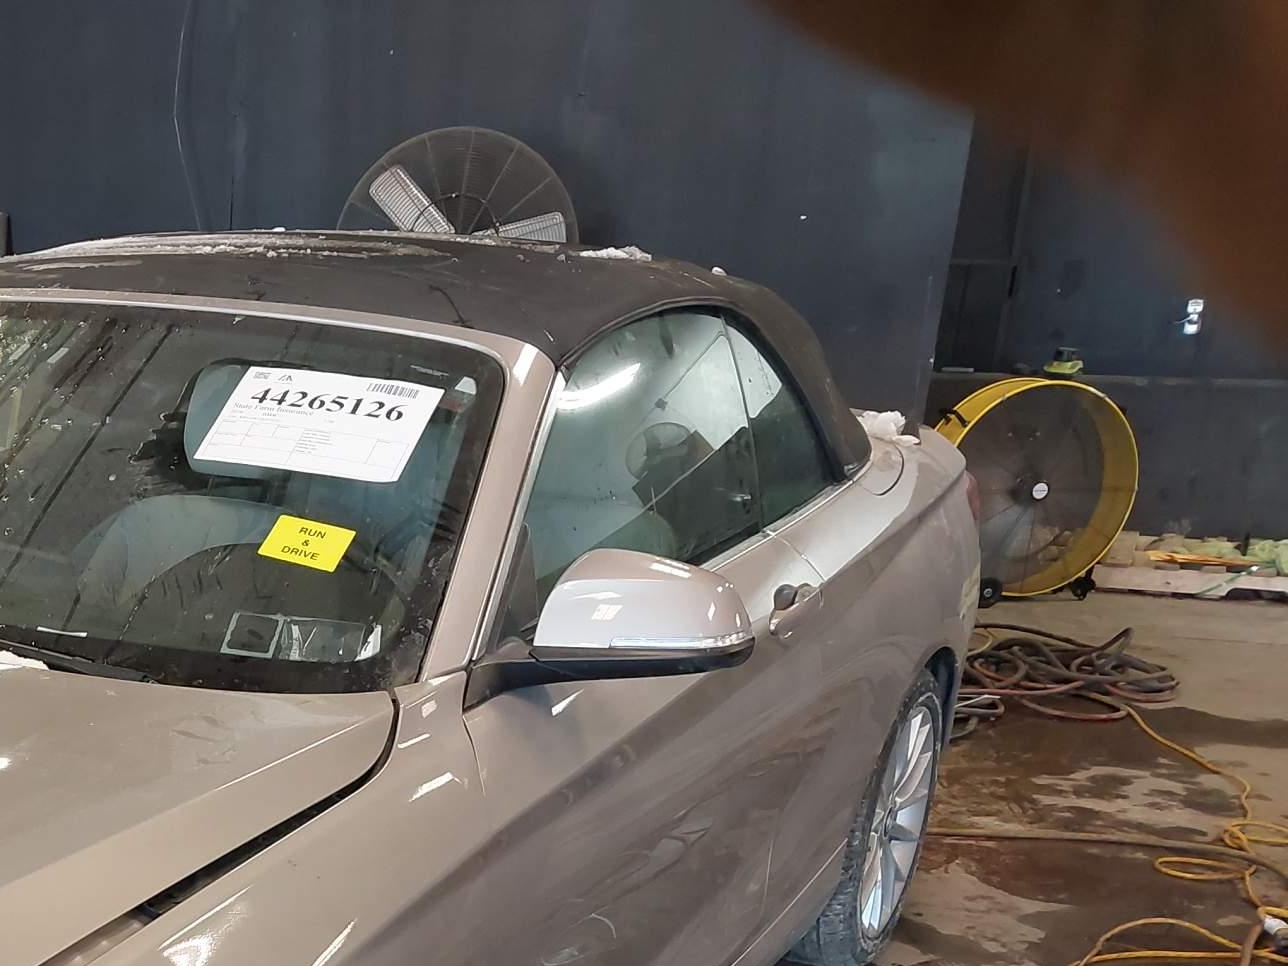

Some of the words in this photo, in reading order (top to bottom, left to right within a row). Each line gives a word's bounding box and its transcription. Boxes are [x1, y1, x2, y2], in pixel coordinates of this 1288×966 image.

[250, 387, 409, 422] 44265126
[298, 526, 327, 540] RUN
[301, 539, 311, 547] &
[281, 545, 320, 561] DRIVE
